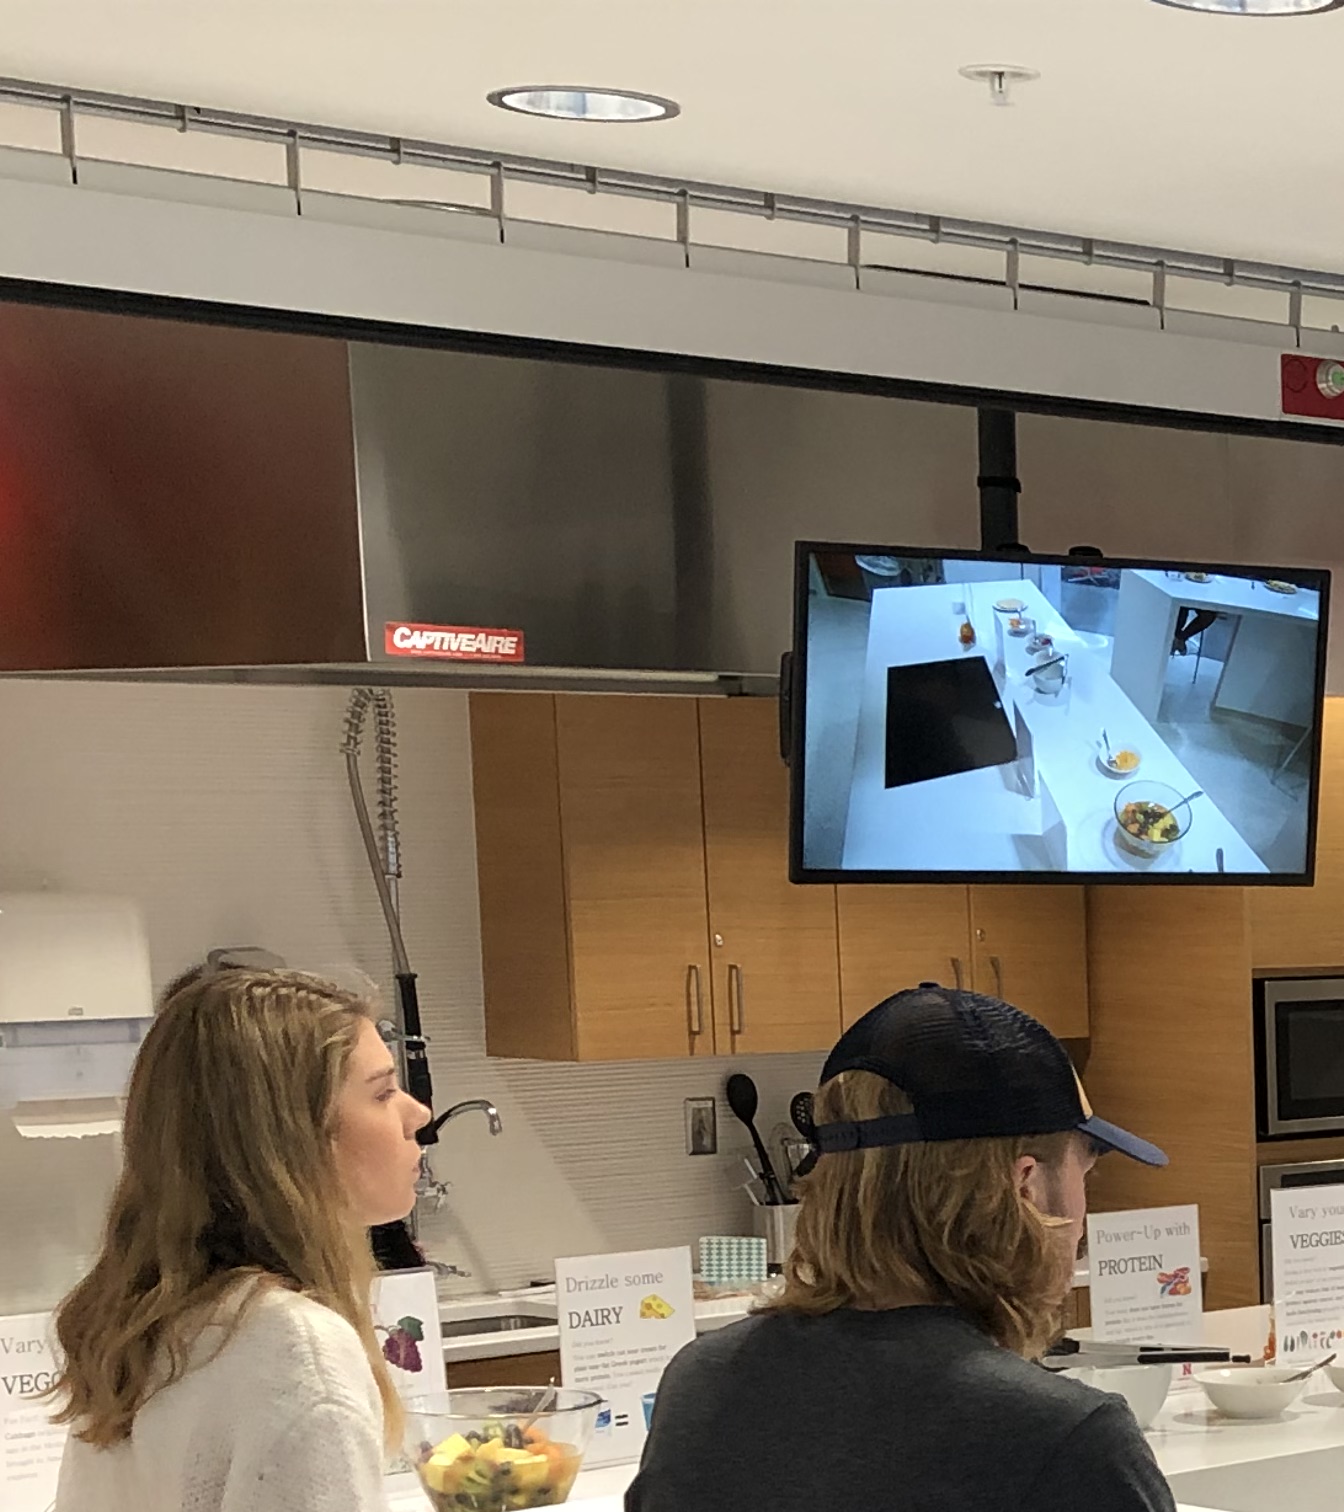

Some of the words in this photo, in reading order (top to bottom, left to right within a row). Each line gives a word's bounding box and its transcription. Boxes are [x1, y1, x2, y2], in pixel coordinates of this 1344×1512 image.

[1289, 1205, 1318, 1220] Vary
[1096, 1223, 1162, 1245] Power-Up
[1165, 1221, 1191, 1237] with
[1098, 1254, 1164, 1277] PROTEIN
[565, 1273, 619, 1293] Drizzle
[624, 1271, 664, 1287] some
[568, 1305, 624, 1330] DAIRY
[0, 1337, 46, 1355] Vary
